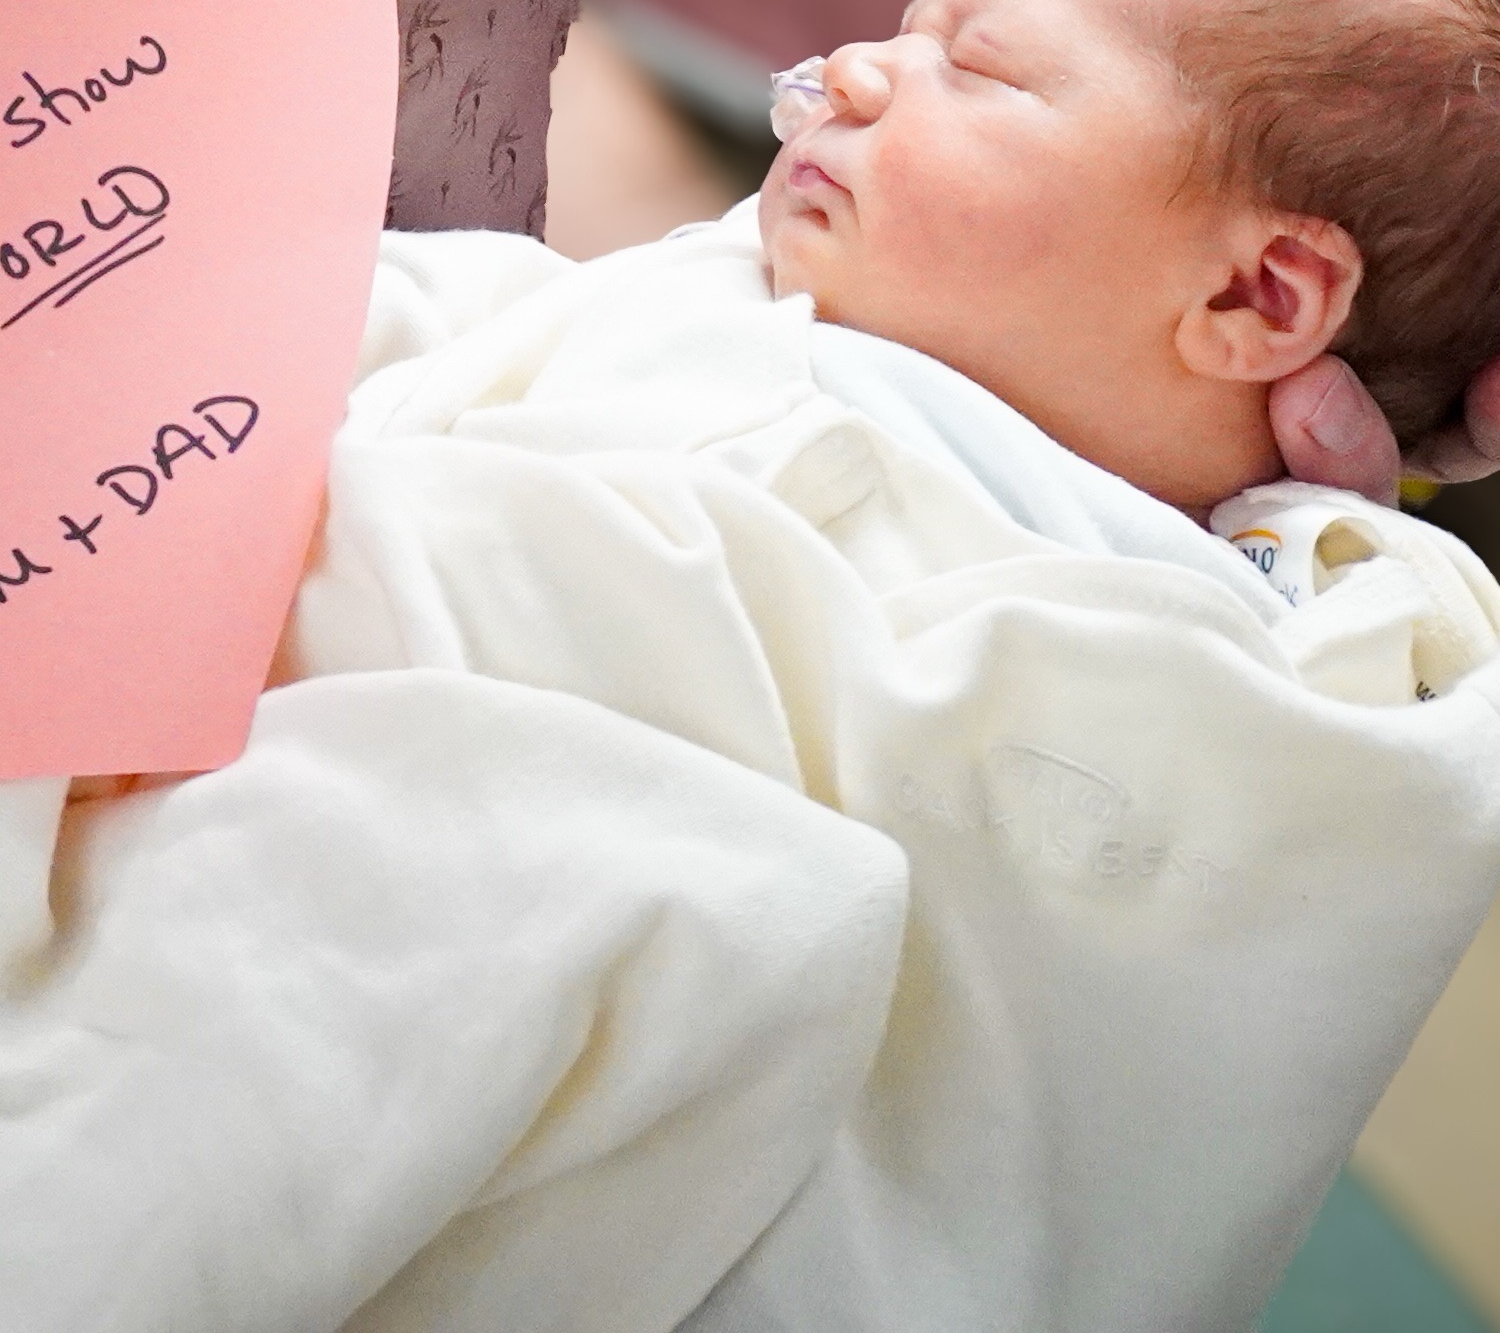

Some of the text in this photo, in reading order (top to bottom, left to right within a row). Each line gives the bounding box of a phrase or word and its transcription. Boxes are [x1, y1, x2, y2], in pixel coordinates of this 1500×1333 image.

[2, 36, 167, 149] show
[58, 514, 103, 555] +
[96, 395, 259, 516] DAD
